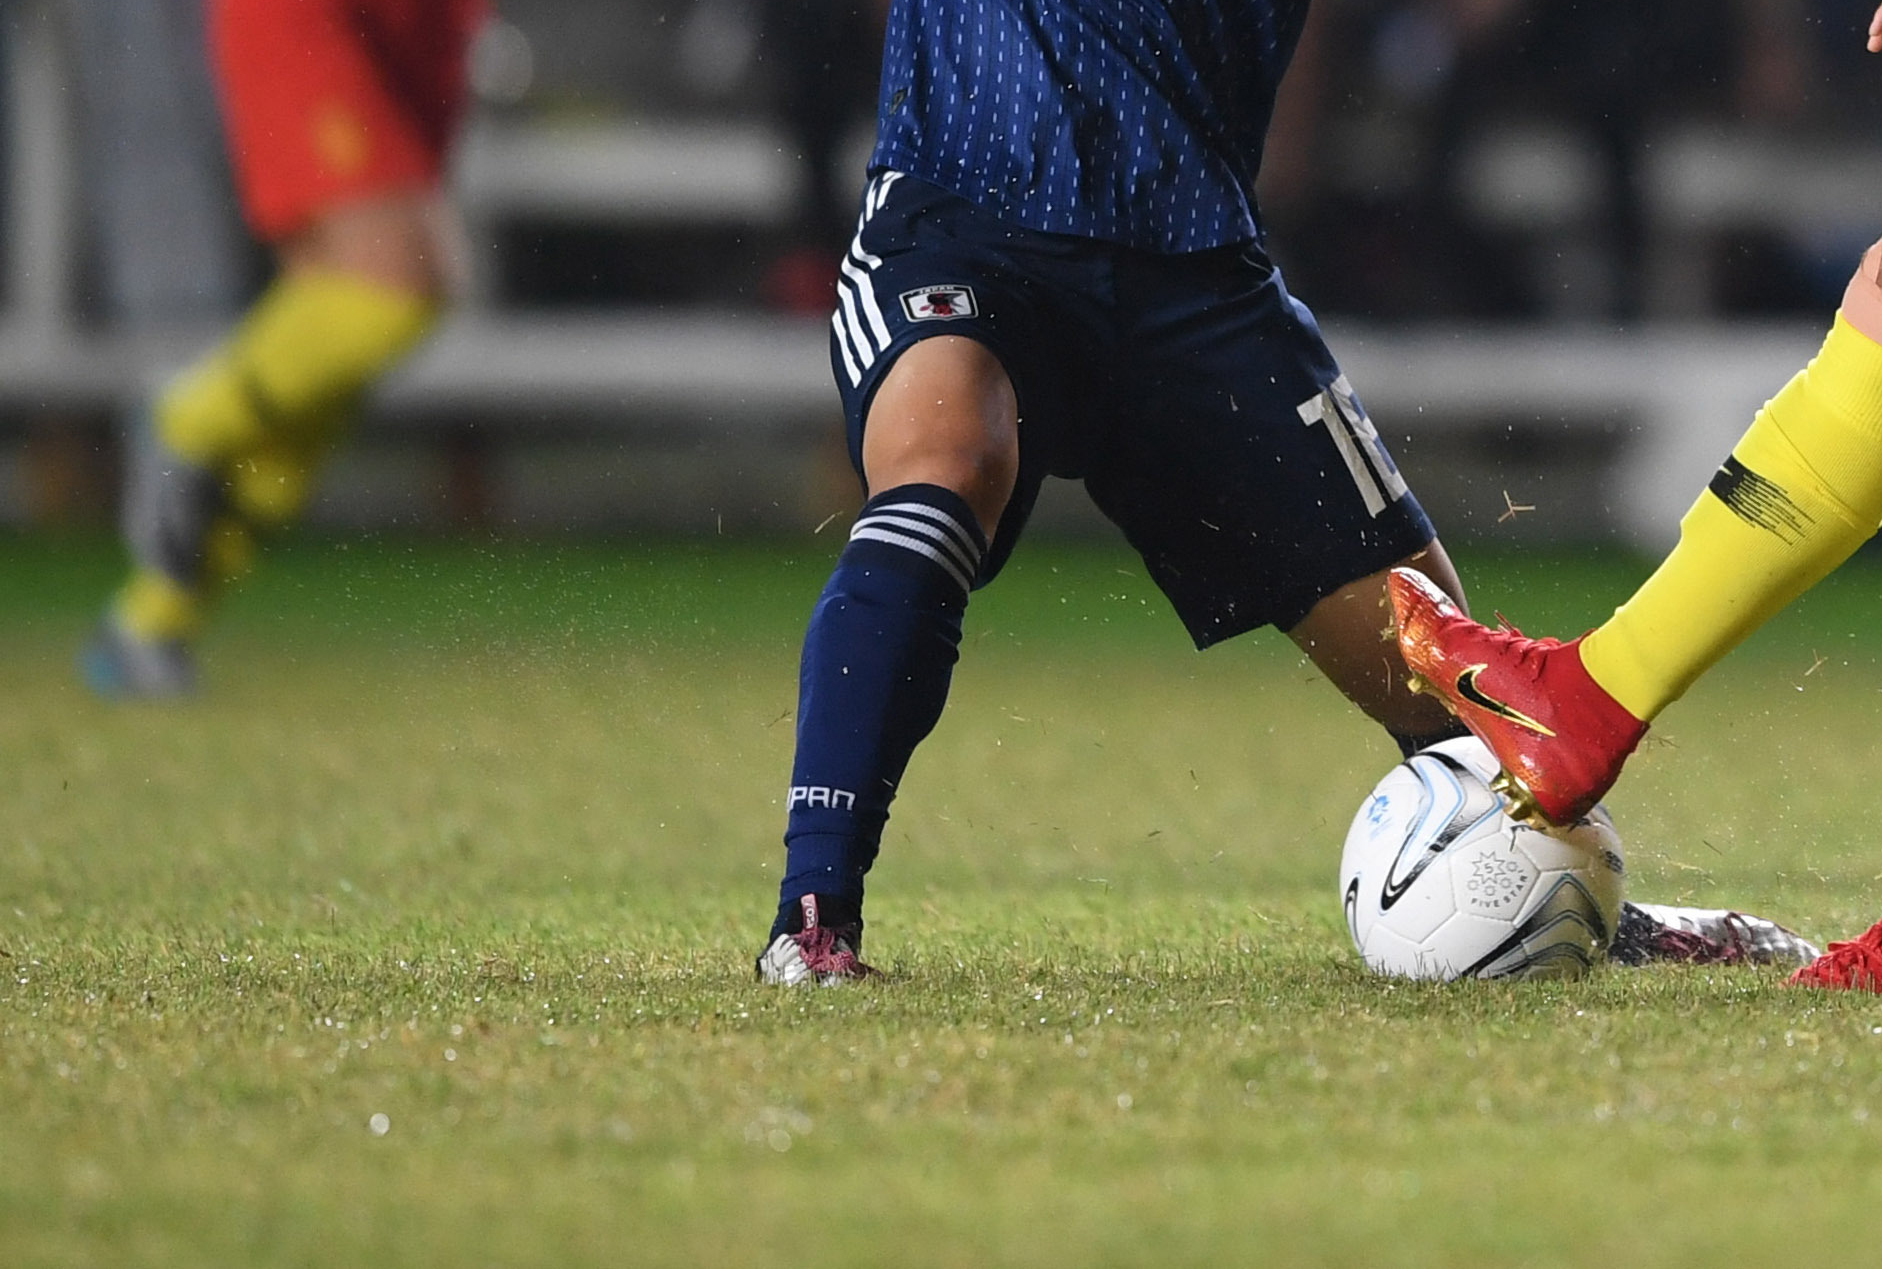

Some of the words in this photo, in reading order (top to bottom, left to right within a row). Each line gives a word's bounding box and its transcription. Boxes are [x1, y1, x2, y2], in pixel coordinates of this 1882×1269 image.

[787, 785, 856, 812] PAN
[1484, 863, 1494, 874] 5
[1470, 897, 1500, 908] FIVE
